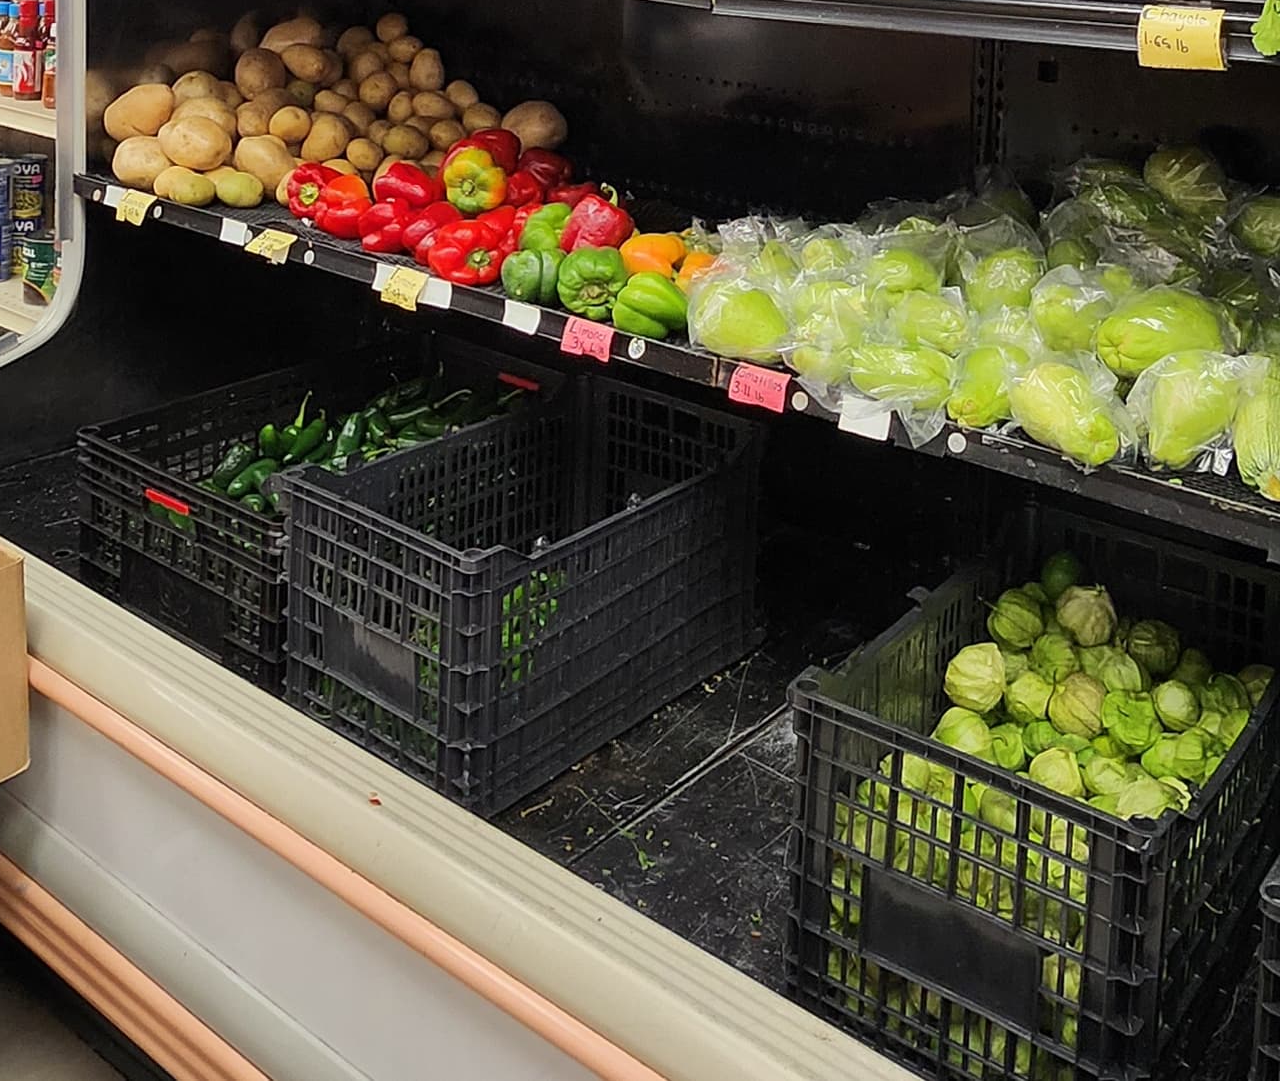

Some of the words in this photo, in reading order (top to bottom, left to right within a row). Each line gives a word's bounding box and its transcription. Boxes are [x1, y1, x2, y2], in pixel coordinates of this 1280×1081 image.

[1175, 38, 1190, 54] lb
[13, 163, 41, 175] OYA
[755, 390, 765, 403] lb
